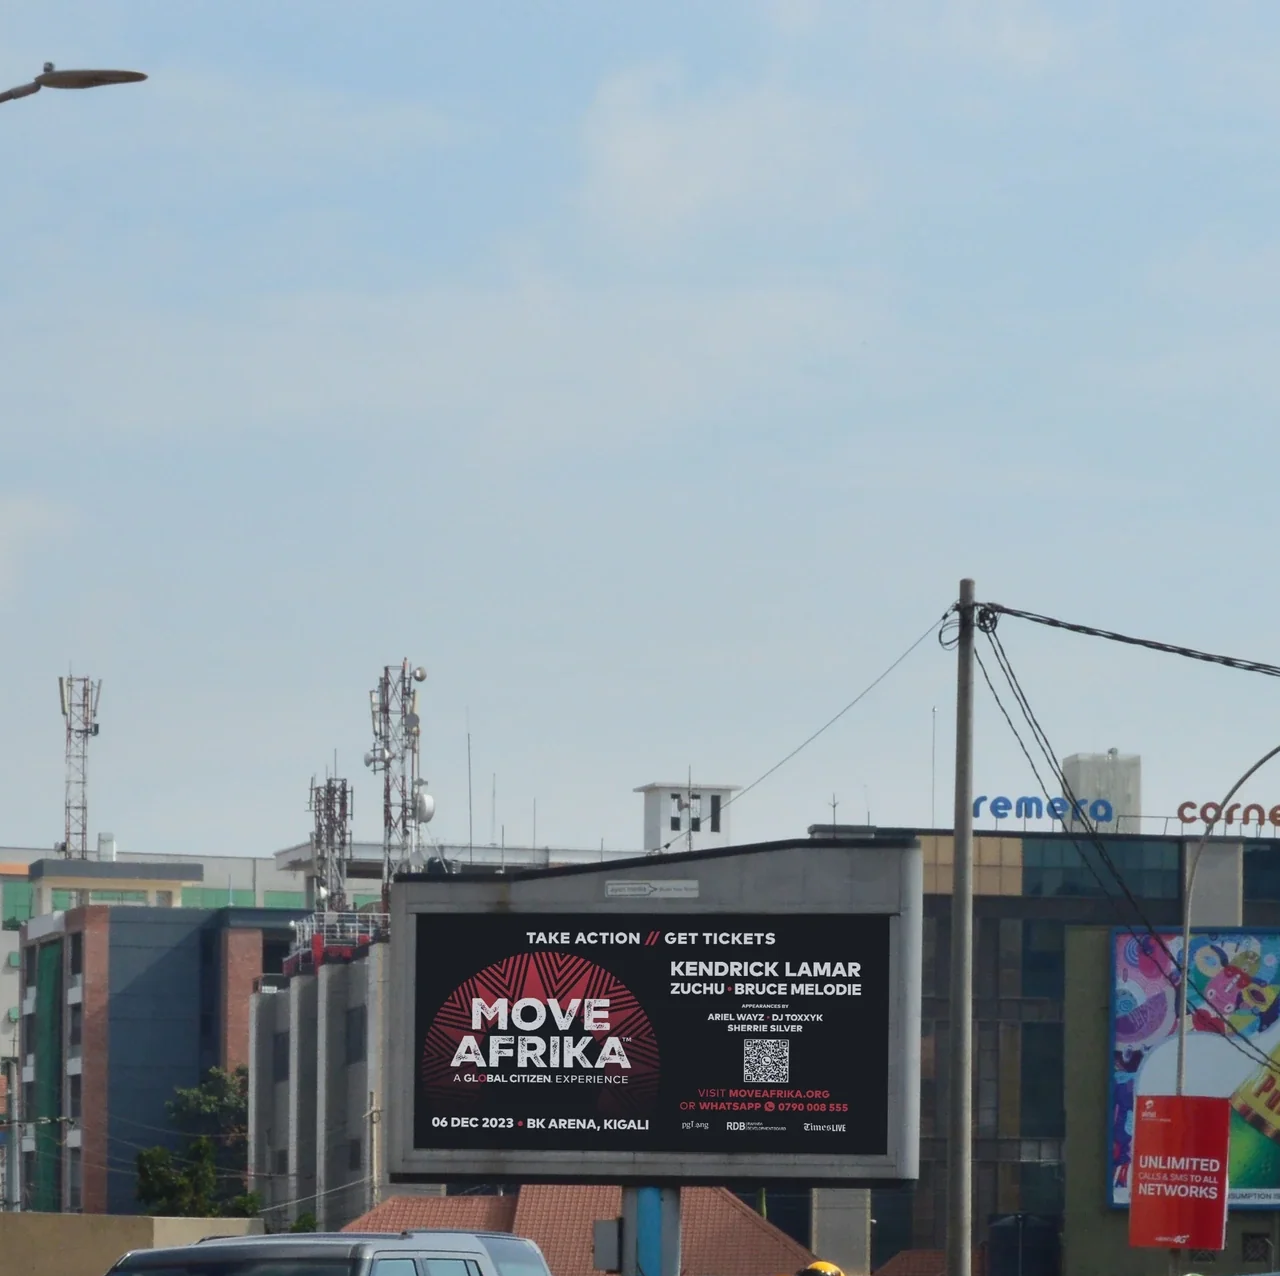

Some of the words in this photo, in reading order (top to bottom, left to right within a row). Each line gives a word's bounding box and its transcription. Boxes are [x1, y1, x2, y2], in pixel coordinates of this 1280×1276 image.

[972, 796, 1113, 822] remera
[526, 932, 570, 944] TAKE
[574, 932, 641, 944] ACTION
[664, 932, 699, 945] GET
[702, 932, 776, 945] TICKETS
[670, 961, 779, 977] KENDRICK
[785, 962, 861, 977] LAMAR
[670, 983, 725, 995] ZUCHU
[734, 983, 787, 996] BRUCE
[790, 983, 862, 996] MELODIE
[471, 997, 611, 1031] MOVE
[707, 1013, 735, 1021] ARIEL
[736, 1013, 765, 1022] WAYZ
[771, 1014, 783, 1022] DJ
[785, 1014, 823, 1022] TOXXYK
[727, 1024, 768, 1032] SHERRIE
[770, 1024, 803, 1032] SILVER
[450, 1035, 632, 1069] AFRIKA
[453, 1074, 461, 1082] A
[463, 1074, 508, 1083] GLOBAL
[555, 1074, 629, 1084] EXPERIENCE
[697, 1088, 726, 1098] VISIT
[728, 1088, 831, 1099] MOVEAFRIKA.ORG
[679, 1102, 696, 1111] OR
[699, 1102, 762, 1111] WHATSAPP
[778, 1103, 804, 1112] 0790
[806, 1103, 827, 1112] 008
[829, 1103, 849, 1112] 555
[431, 1117, 448, 1127] 06
[451, 1117, 479, 1128] DEC
[482, 1117, 514, 1128] 2023
[526, 1118, 546, 1129] BK
[548, 1118, 601, 1132] ARENA,
[603, 1119, 649, 1130] KIGALI
[726, 1121, 746, 1131] RDB
[1139, 1155, 1220, 1172] UNLIMITED
[1138, 1172, 1162, 1181] CALLS
[1170, 1173, 1188, 1182] SMS
[1190, 1174, 1201, 1183] TO
[1203, 1176, 1218, 1184] ALL
[1138, 1183, 1218, 1199] NETWORKS
